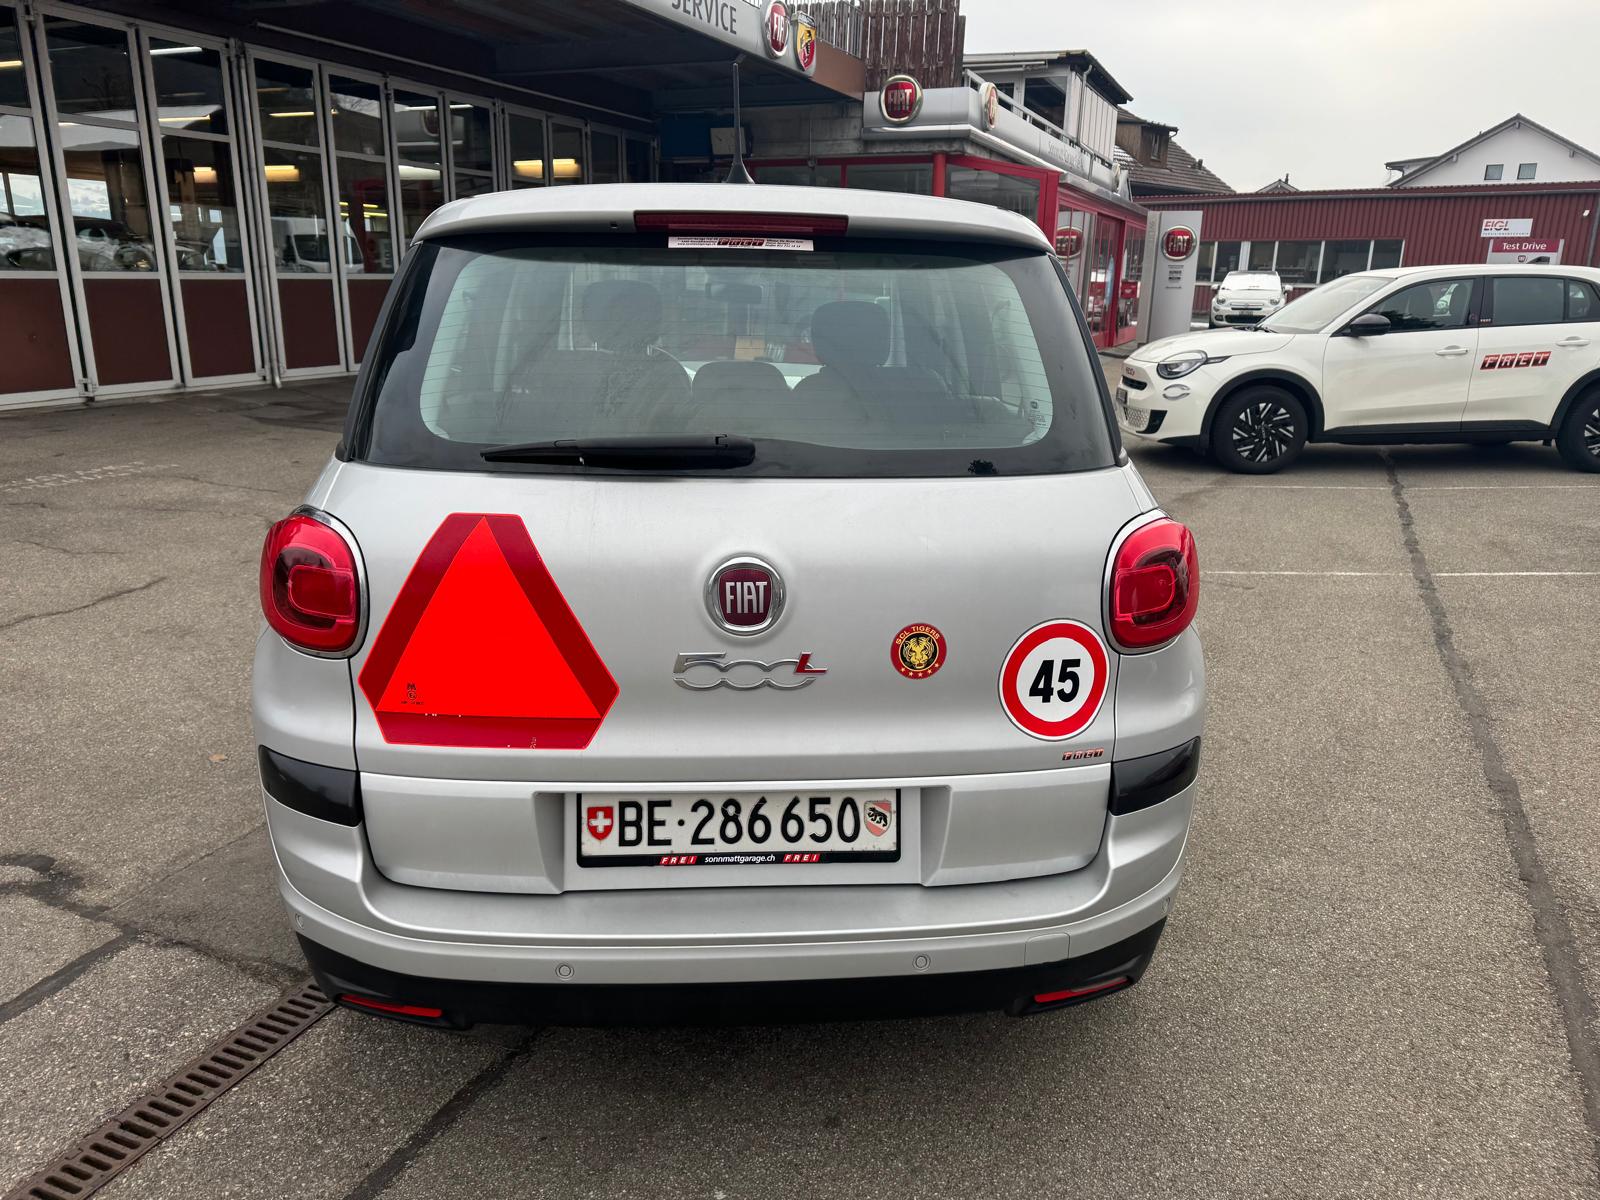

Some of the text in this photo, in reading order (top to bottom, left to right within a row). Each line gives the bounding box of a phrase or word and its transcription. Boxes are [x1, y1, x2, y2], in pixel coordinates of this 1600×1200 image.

[887, 89, 913, 112] FIAT
[1168, 235, 1190, 252] FIAT
[1503, 242, 1547, 250] Test Drive
[725, 581, 768, 614] FIAT
[896, 625, 941, 645] SCL TIGERS
[1028, 658, 1081, 703] 45
[660, 853, 820, 865] FREI sonnmattgarage.ch FREI
